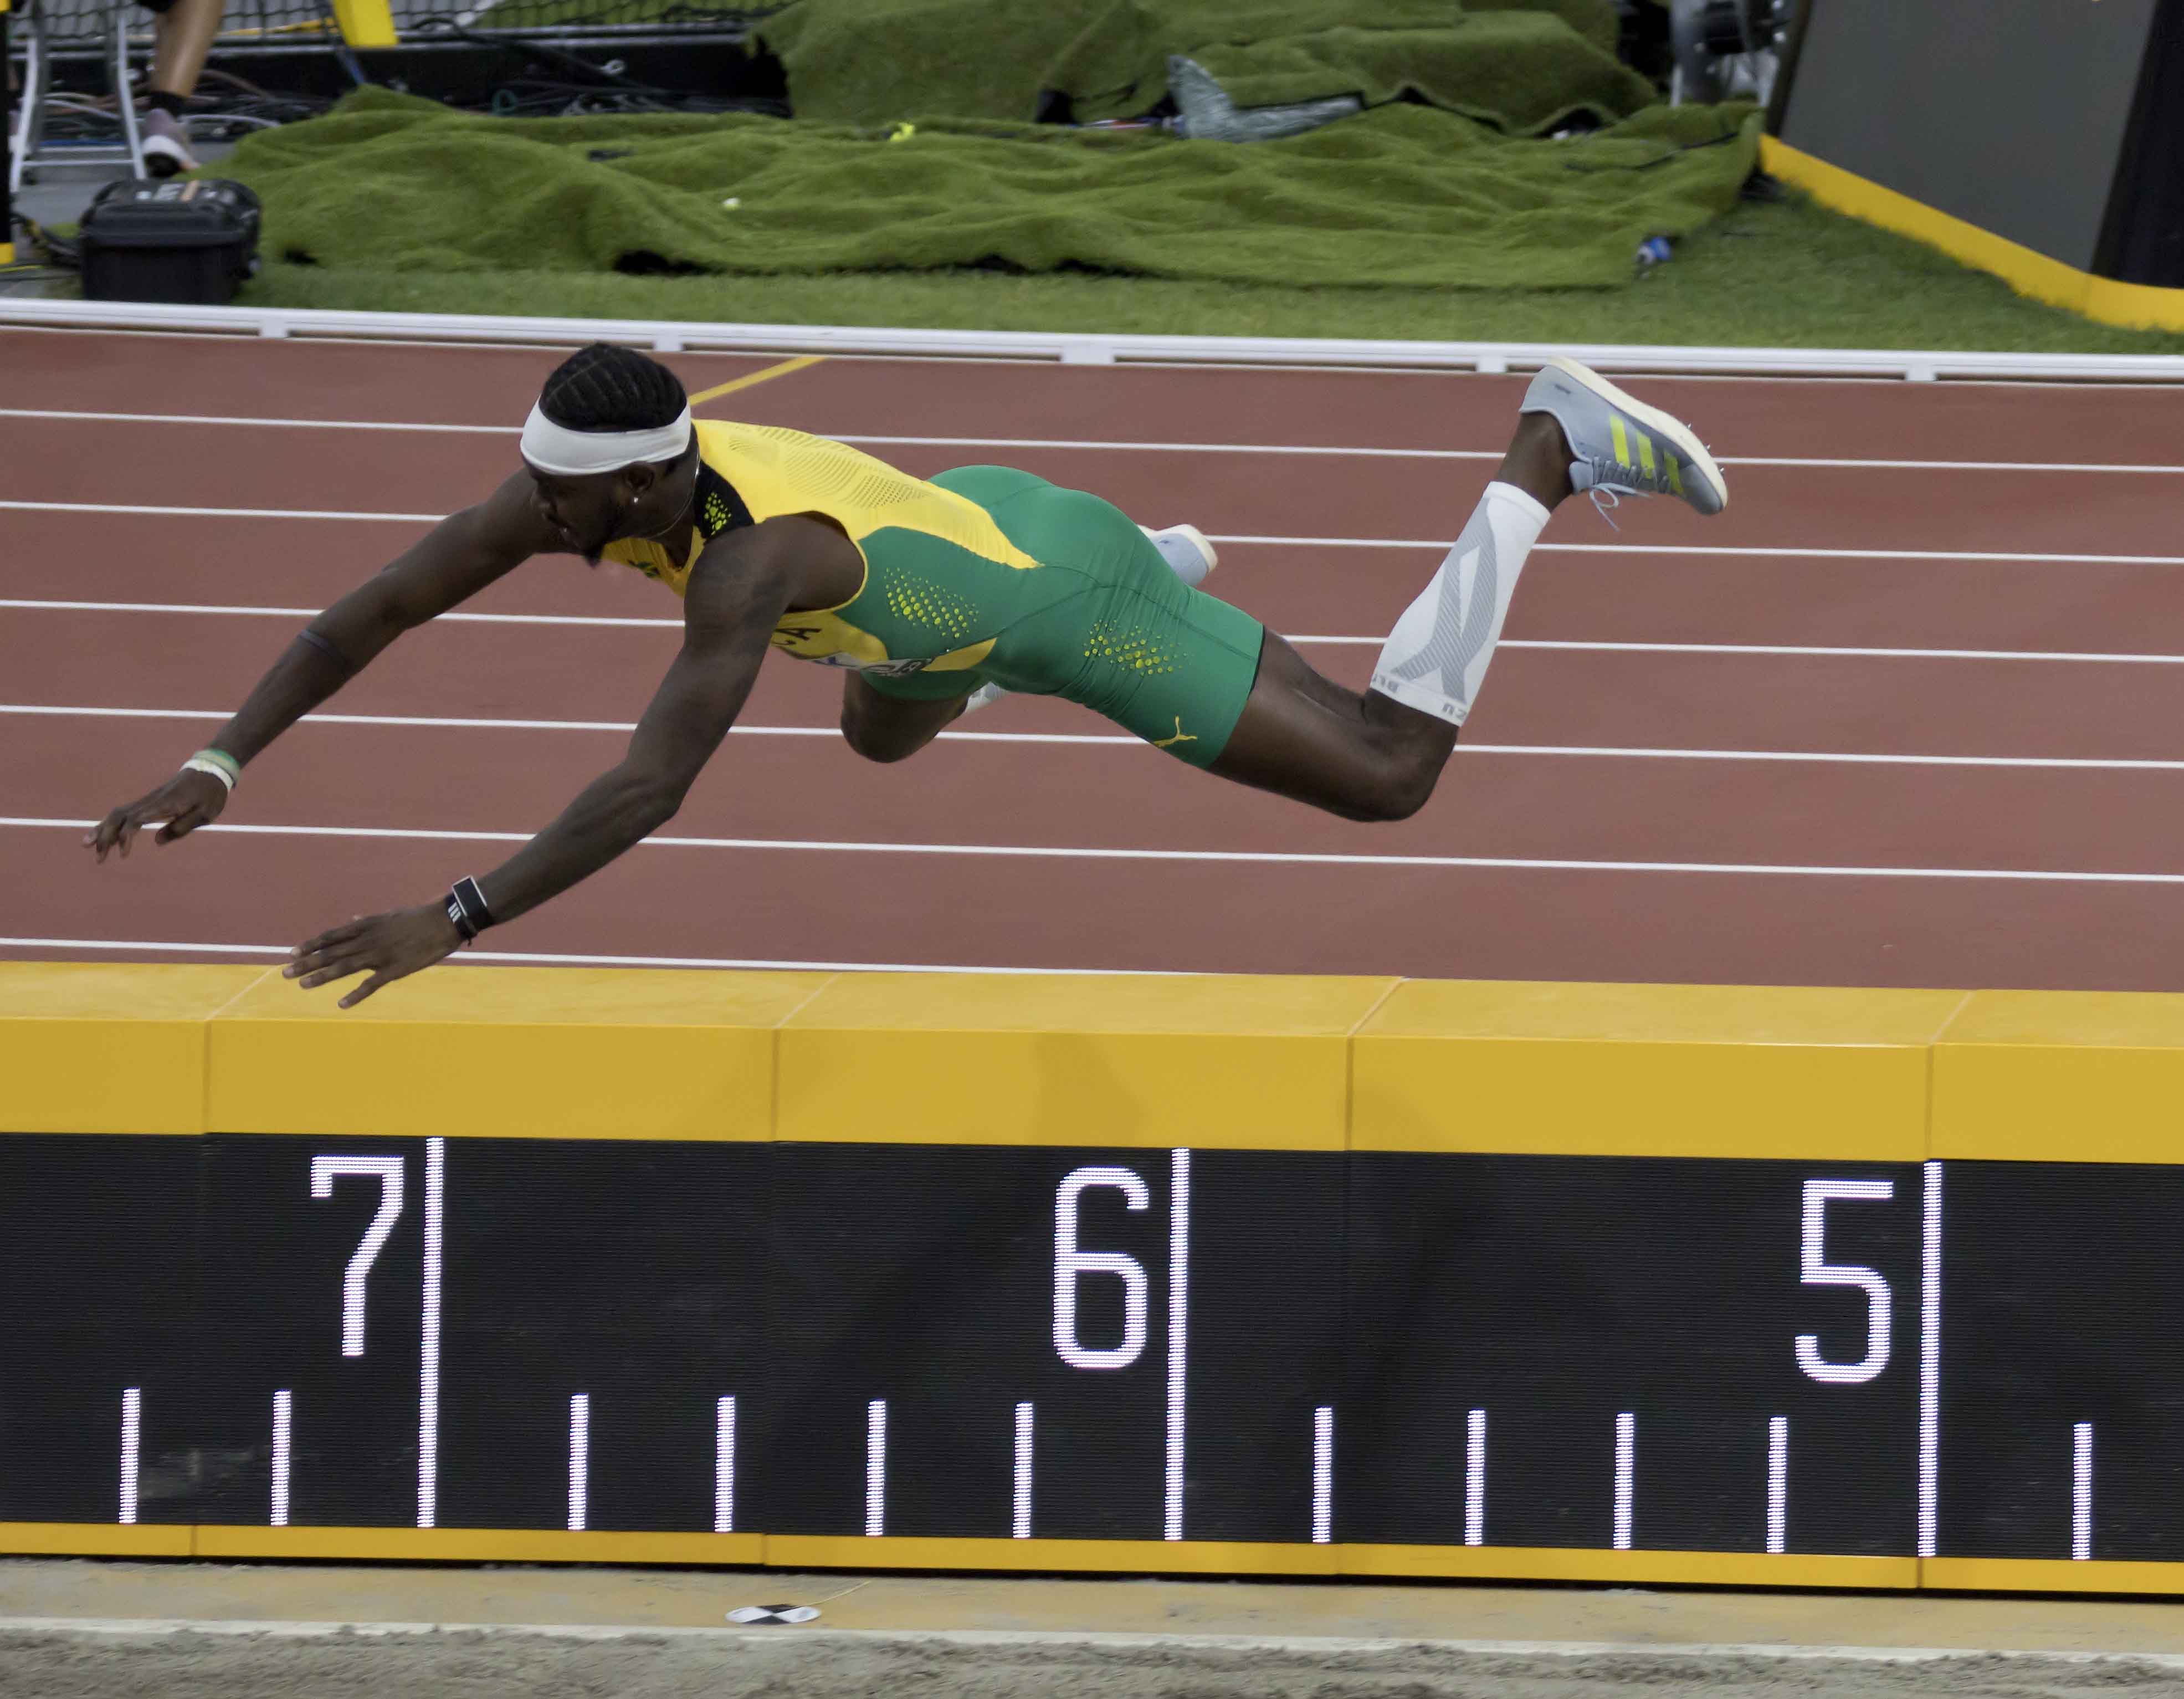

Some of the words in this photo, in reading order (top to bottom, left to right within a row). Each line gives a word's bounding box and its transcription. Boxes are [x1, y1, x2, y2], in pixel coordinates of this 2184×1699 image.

[311, 1155, 404, 1357] 7
[1052, 1166, 1149, 1368] 6
[1795, 1180, 1893, 1382] 5
